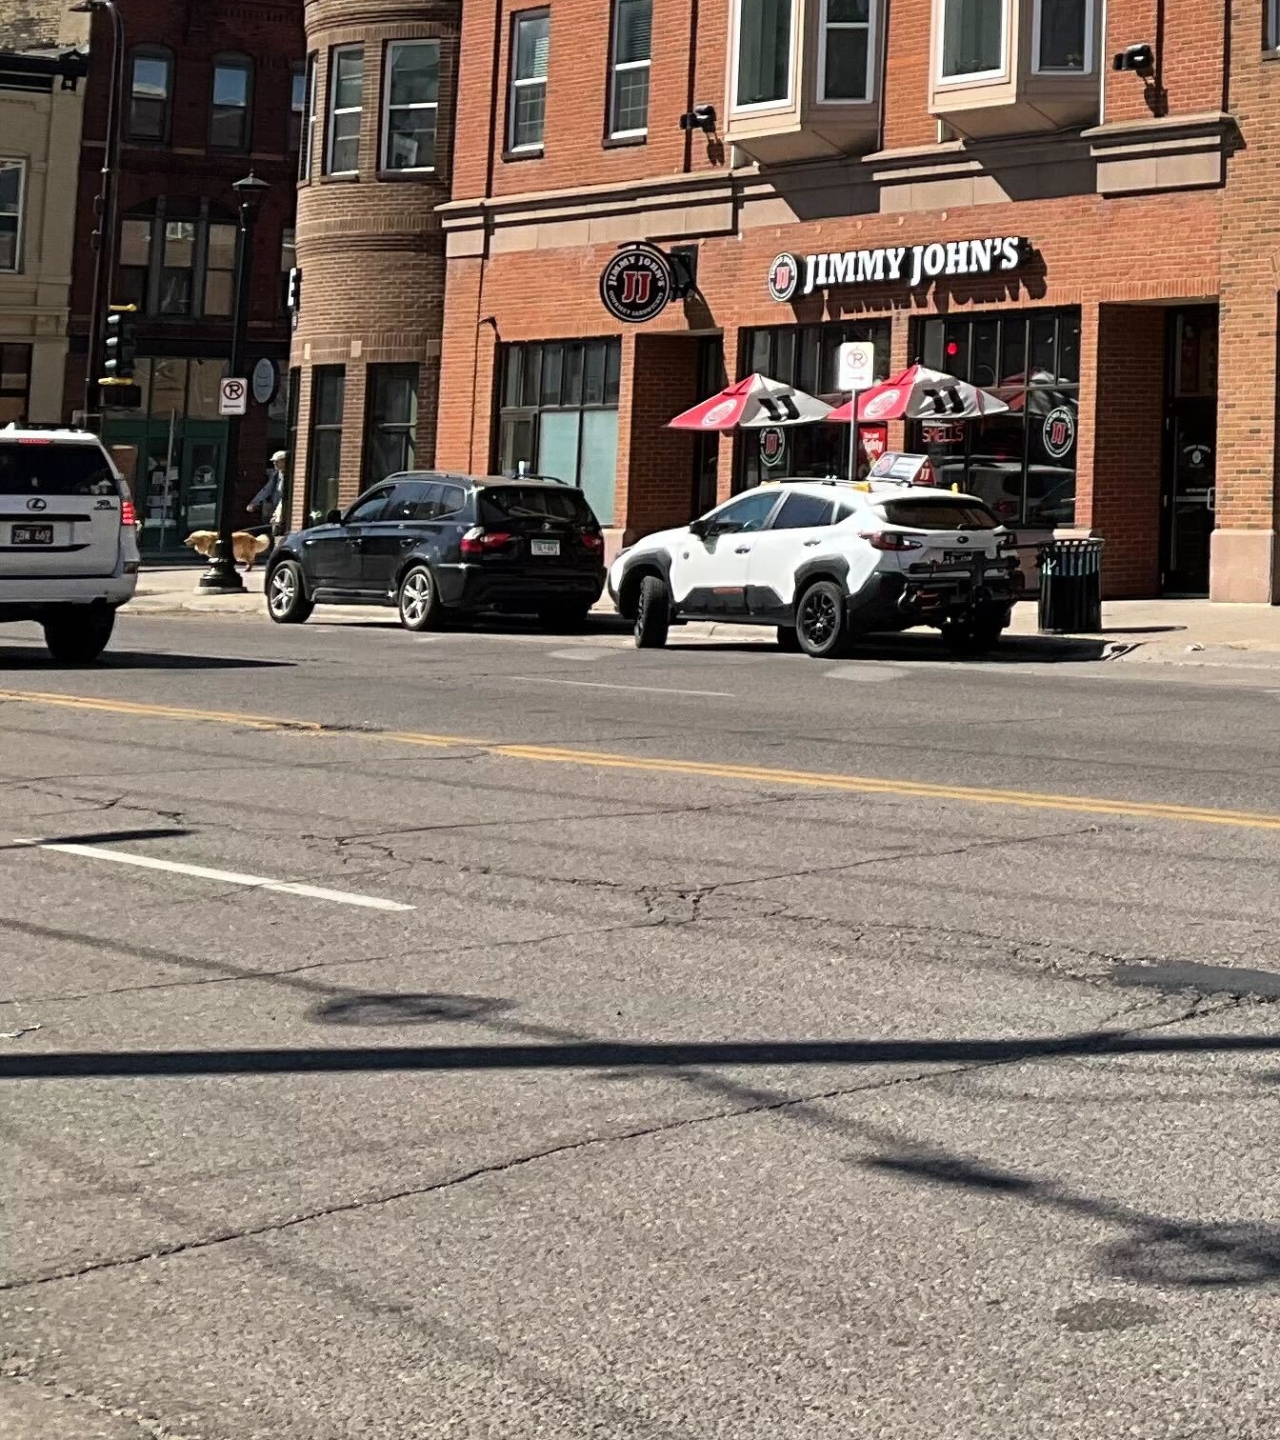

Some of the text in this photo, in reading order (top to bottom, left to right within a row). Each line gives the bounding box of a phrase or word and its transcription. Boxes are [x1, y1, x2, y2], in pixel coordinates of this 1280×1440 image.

[607, 255, 666, 287] JIMMY JOHN'S
[803, 247, 906, 294] JIMMY
[910, 236, 1019, 287] JOHN'S
[621, 271, 652, 303] JJ
